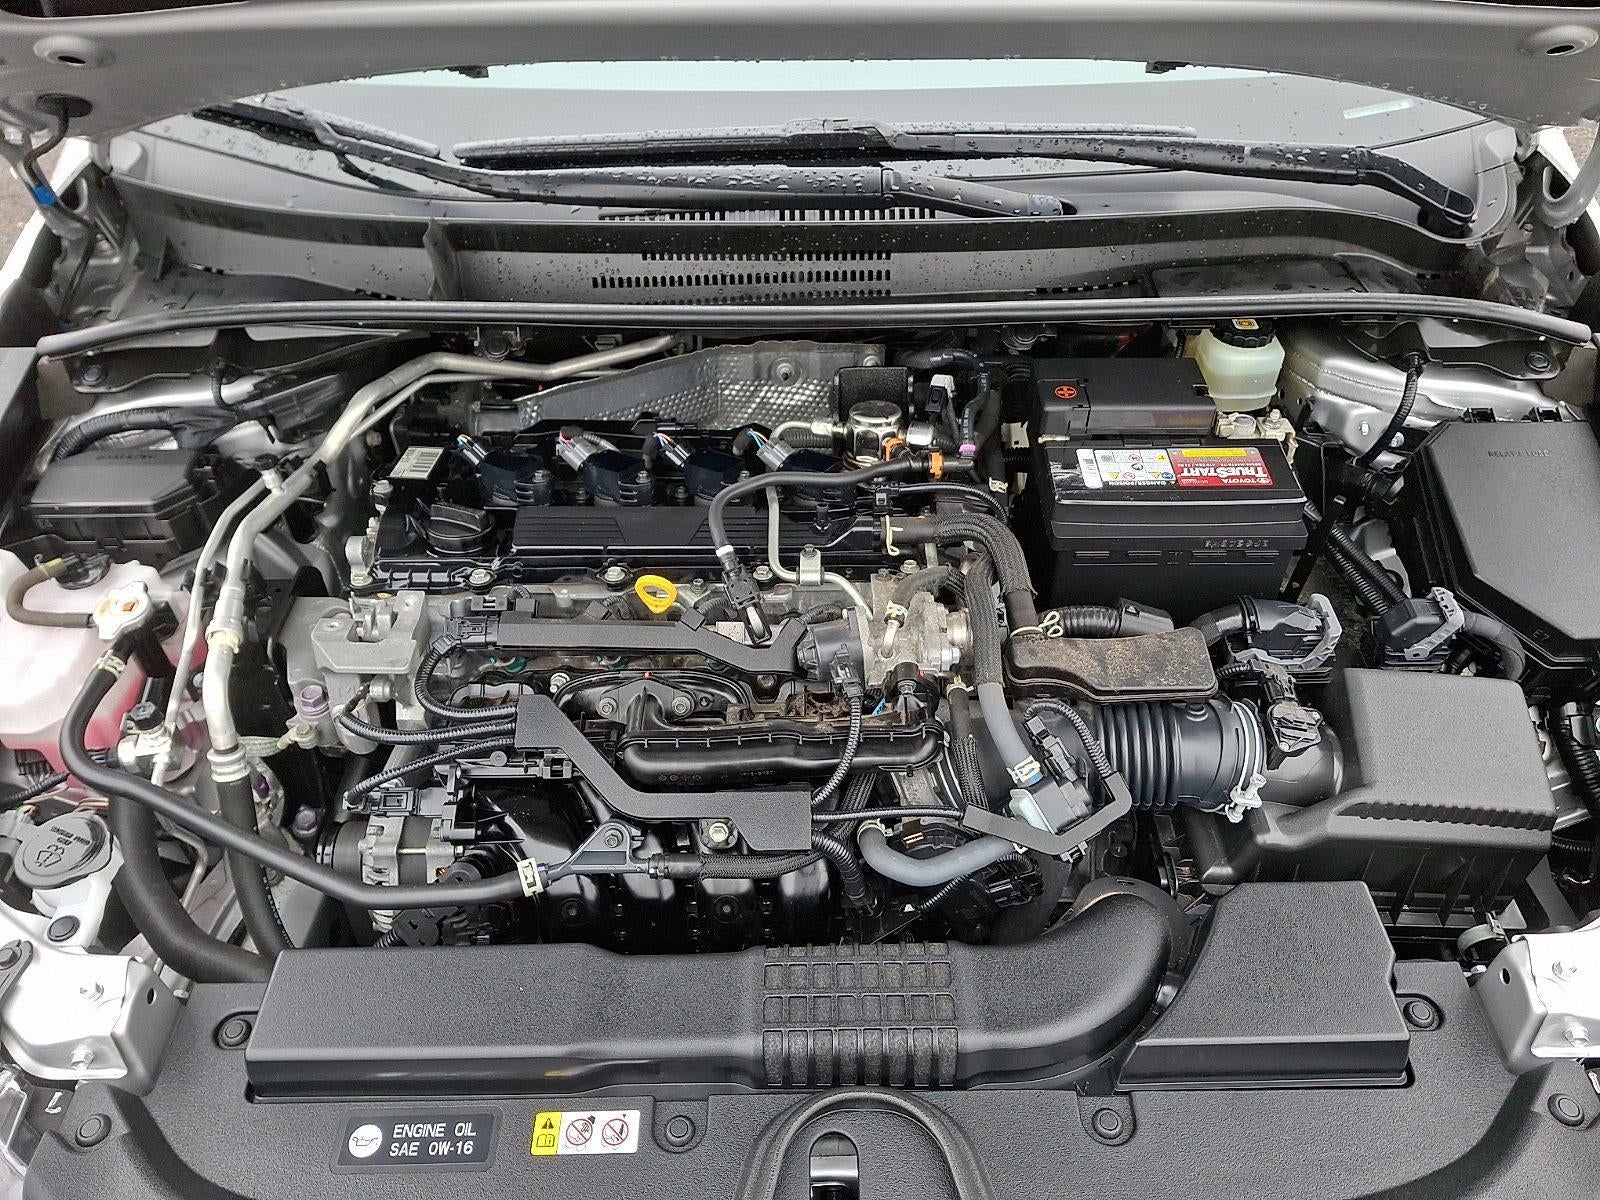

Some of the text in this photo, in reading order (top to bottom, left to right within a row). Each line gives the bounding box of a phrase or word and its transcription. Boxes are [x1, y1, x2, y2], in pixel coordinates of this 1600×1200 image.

[392, 1121, 477, 1138] ENGINE OIL
[389, 1140, 474, 1157] SAE 0W-16
